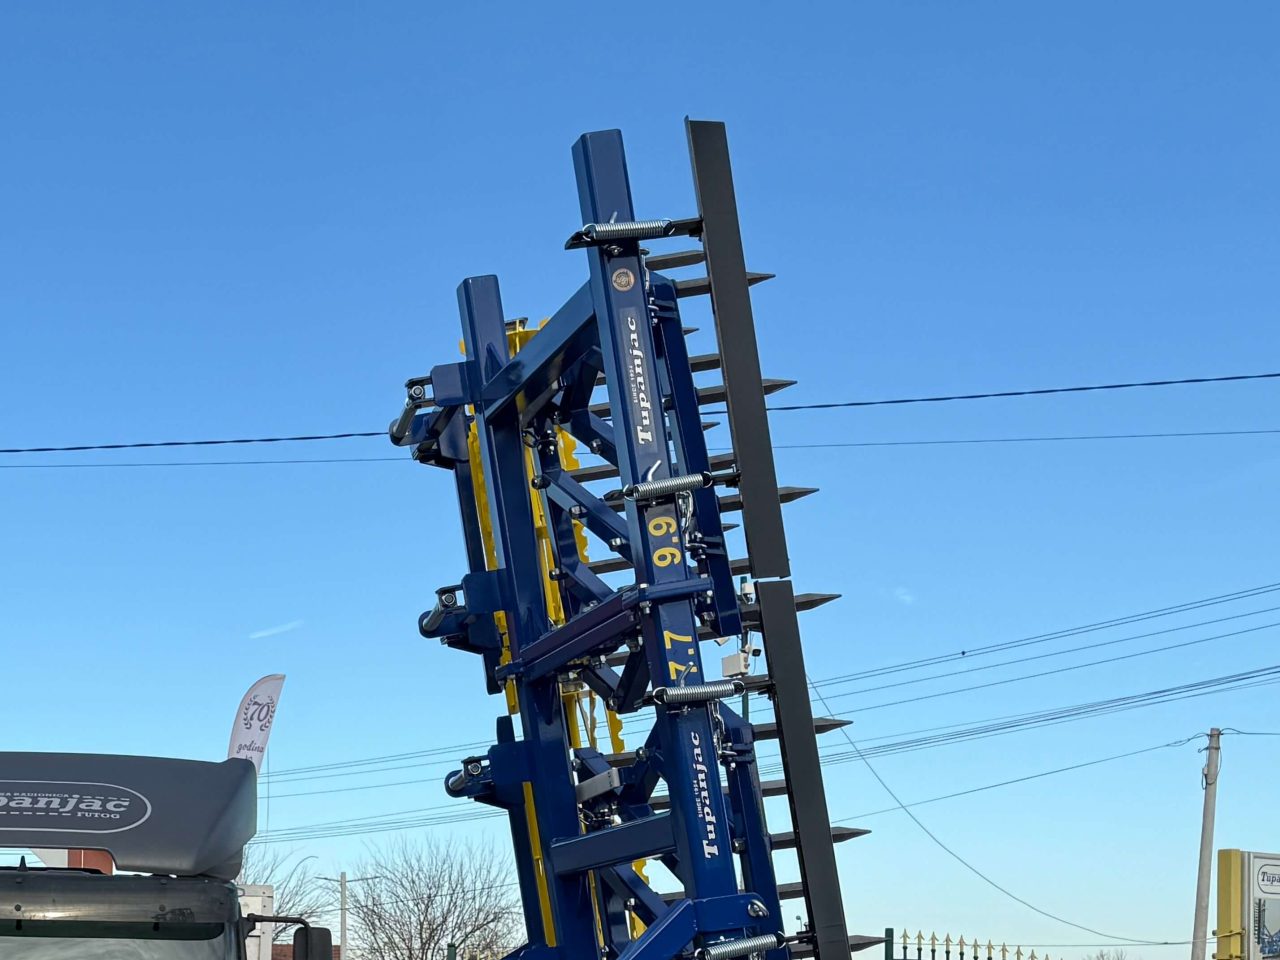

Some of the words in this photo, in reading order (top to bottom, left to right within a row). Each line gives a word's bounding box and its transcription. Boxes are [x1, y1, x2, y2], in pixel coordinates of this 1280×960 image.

[627, 317, 653, 444] Tupanjac
[648, 516, 682, 567] 9.9
[664, 630, 698, 680] 7.7
[249, 701, 271, 722] 70
[690, 731, 719, 859] Tupanjac
